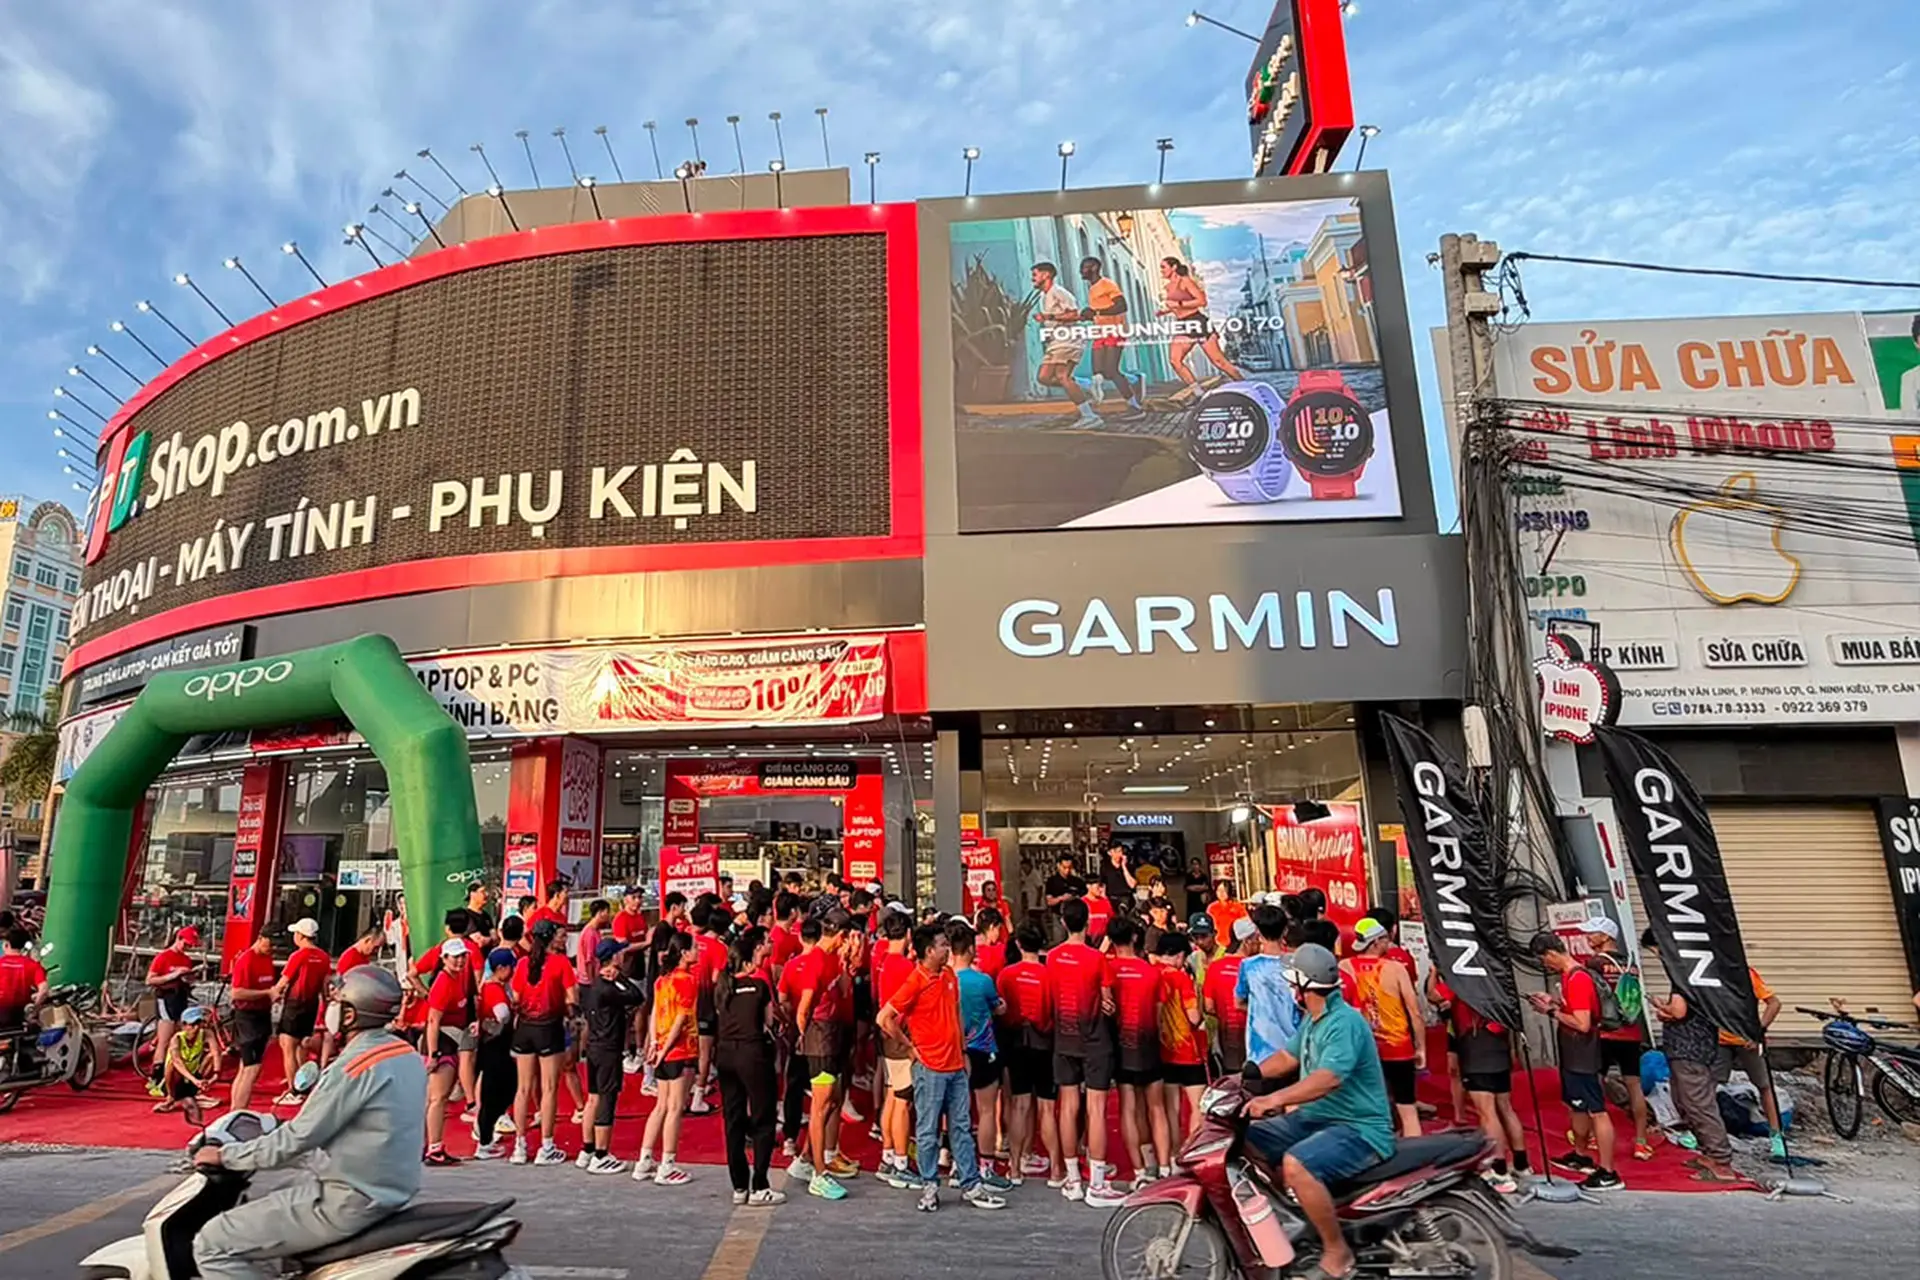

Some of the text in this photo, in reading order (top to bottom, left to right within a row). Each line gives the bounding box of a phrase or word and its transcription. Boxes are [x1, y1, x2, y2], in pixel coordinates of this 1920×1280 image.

[1039, 318, 1203, 342] FORERUNNER
[1257, 316, 1285, 332] 70
[1530, 329, 1857, 395] SỬA CHỮA
[1331, 423, 1359, 440] 10
[91, 556, 158, 615] THOẠI
[175, 518, 255, 587] MÁY
[265, 497, 376, 562] TÍNH
[429, 469, 563, 538] PHỤ
[590, 448, 758, 530] KIỆN
[1526, 575, 1587, 597] OPPO
[998, 587, 1400, 657] GARMIN
[151, 653, 171, 671] CAM
[171, 642, 191, 667] KẾT
[192, 639, 212, 661] GIÁ
[214, 632, 239, 657] TỐT
[781, 647, 814, 664] CÀNG
[1618, 642, 1665, 665] KÍNH
[1707, 637, 1805, 662] SỬA CHỮA
[1841, 640, 1886, 660] MUA
[488, 664, 501, 689] &
[507, 662, 541, 688] PC
[1688, 685, 1710, 697] VĂN
[1751, 684, 1782, 696] HƯNG
[1819, 684, 1844, 695] NINH
[442, 692, 559, 728] ÍNH BẢNG
[1545, 702, 1588, 722] IPHONE
[1818, 701, 1841, 713] 369
[1844, 700, 1868, 713] 379
[793, 762, 824, 773] CÀNG
[826, 763, 850, 773] CAO
[764, 774, 850, 787] GIẢM CÀNG SÂU
[1117, 815, 1173, 825] GARMIN
[1413, 761, 1488, 978] GARMIN
[1634, 767, 1723, 988] GARMIN
